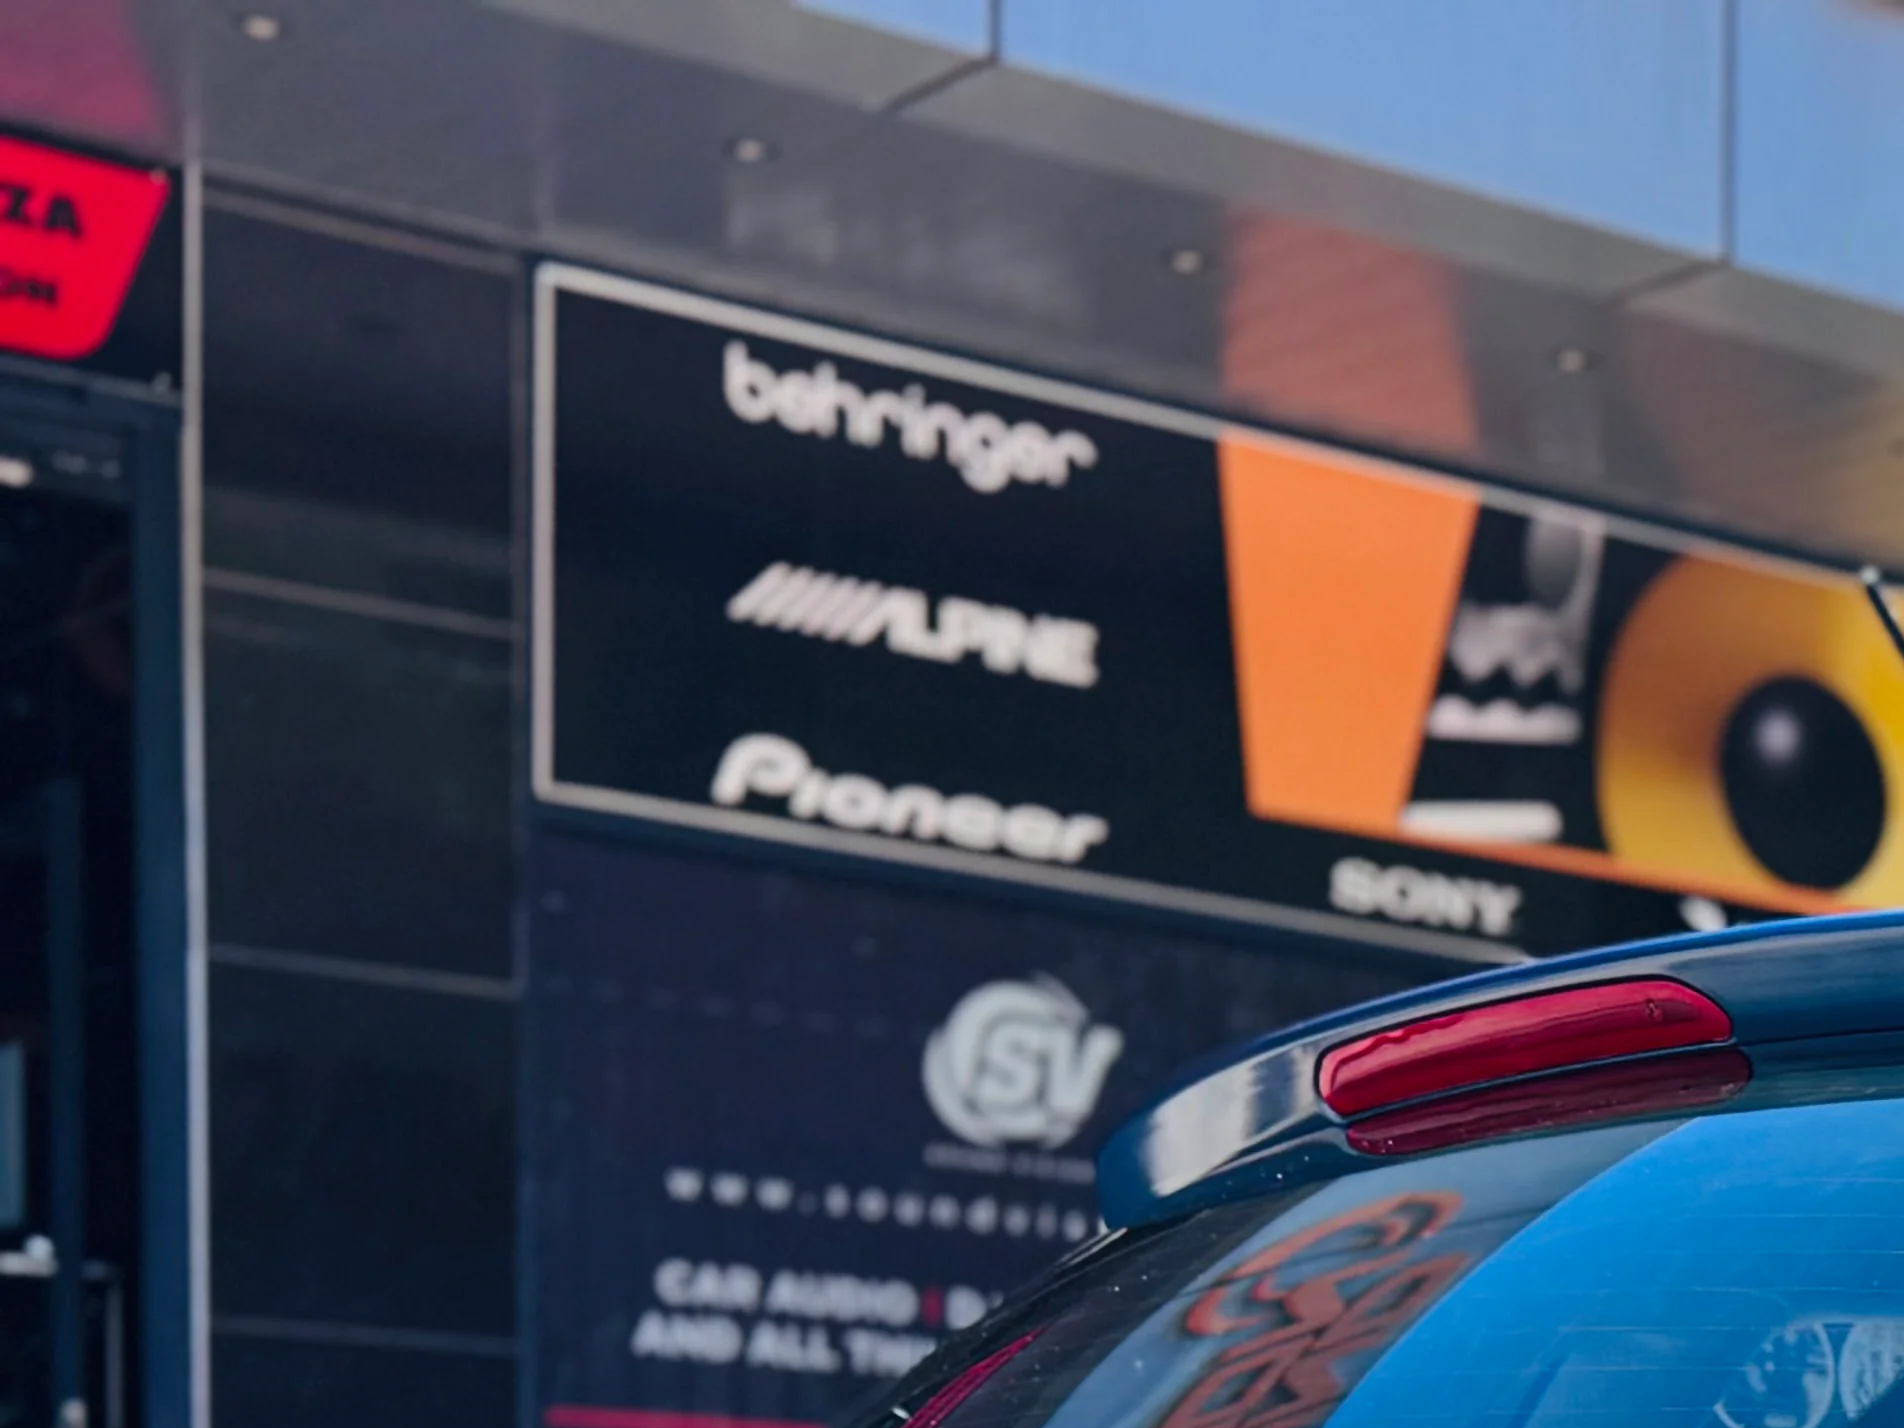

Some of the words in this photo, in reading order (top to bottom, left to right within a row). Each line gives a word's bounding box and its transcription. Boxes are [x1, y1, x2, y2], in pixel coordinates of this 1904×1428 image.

[723, 340, 1099, 493] behringer
[711, 733, 1109, 864] Pioneer
[1329, 856, 1523, 937] SONY
[653, 1257, 762, 1312] CAR
[764, 1269, 921, 1327] AUDIO
[630, 1308, 744, 1365] AND
[745, 1318, 842, 1373] ALL
